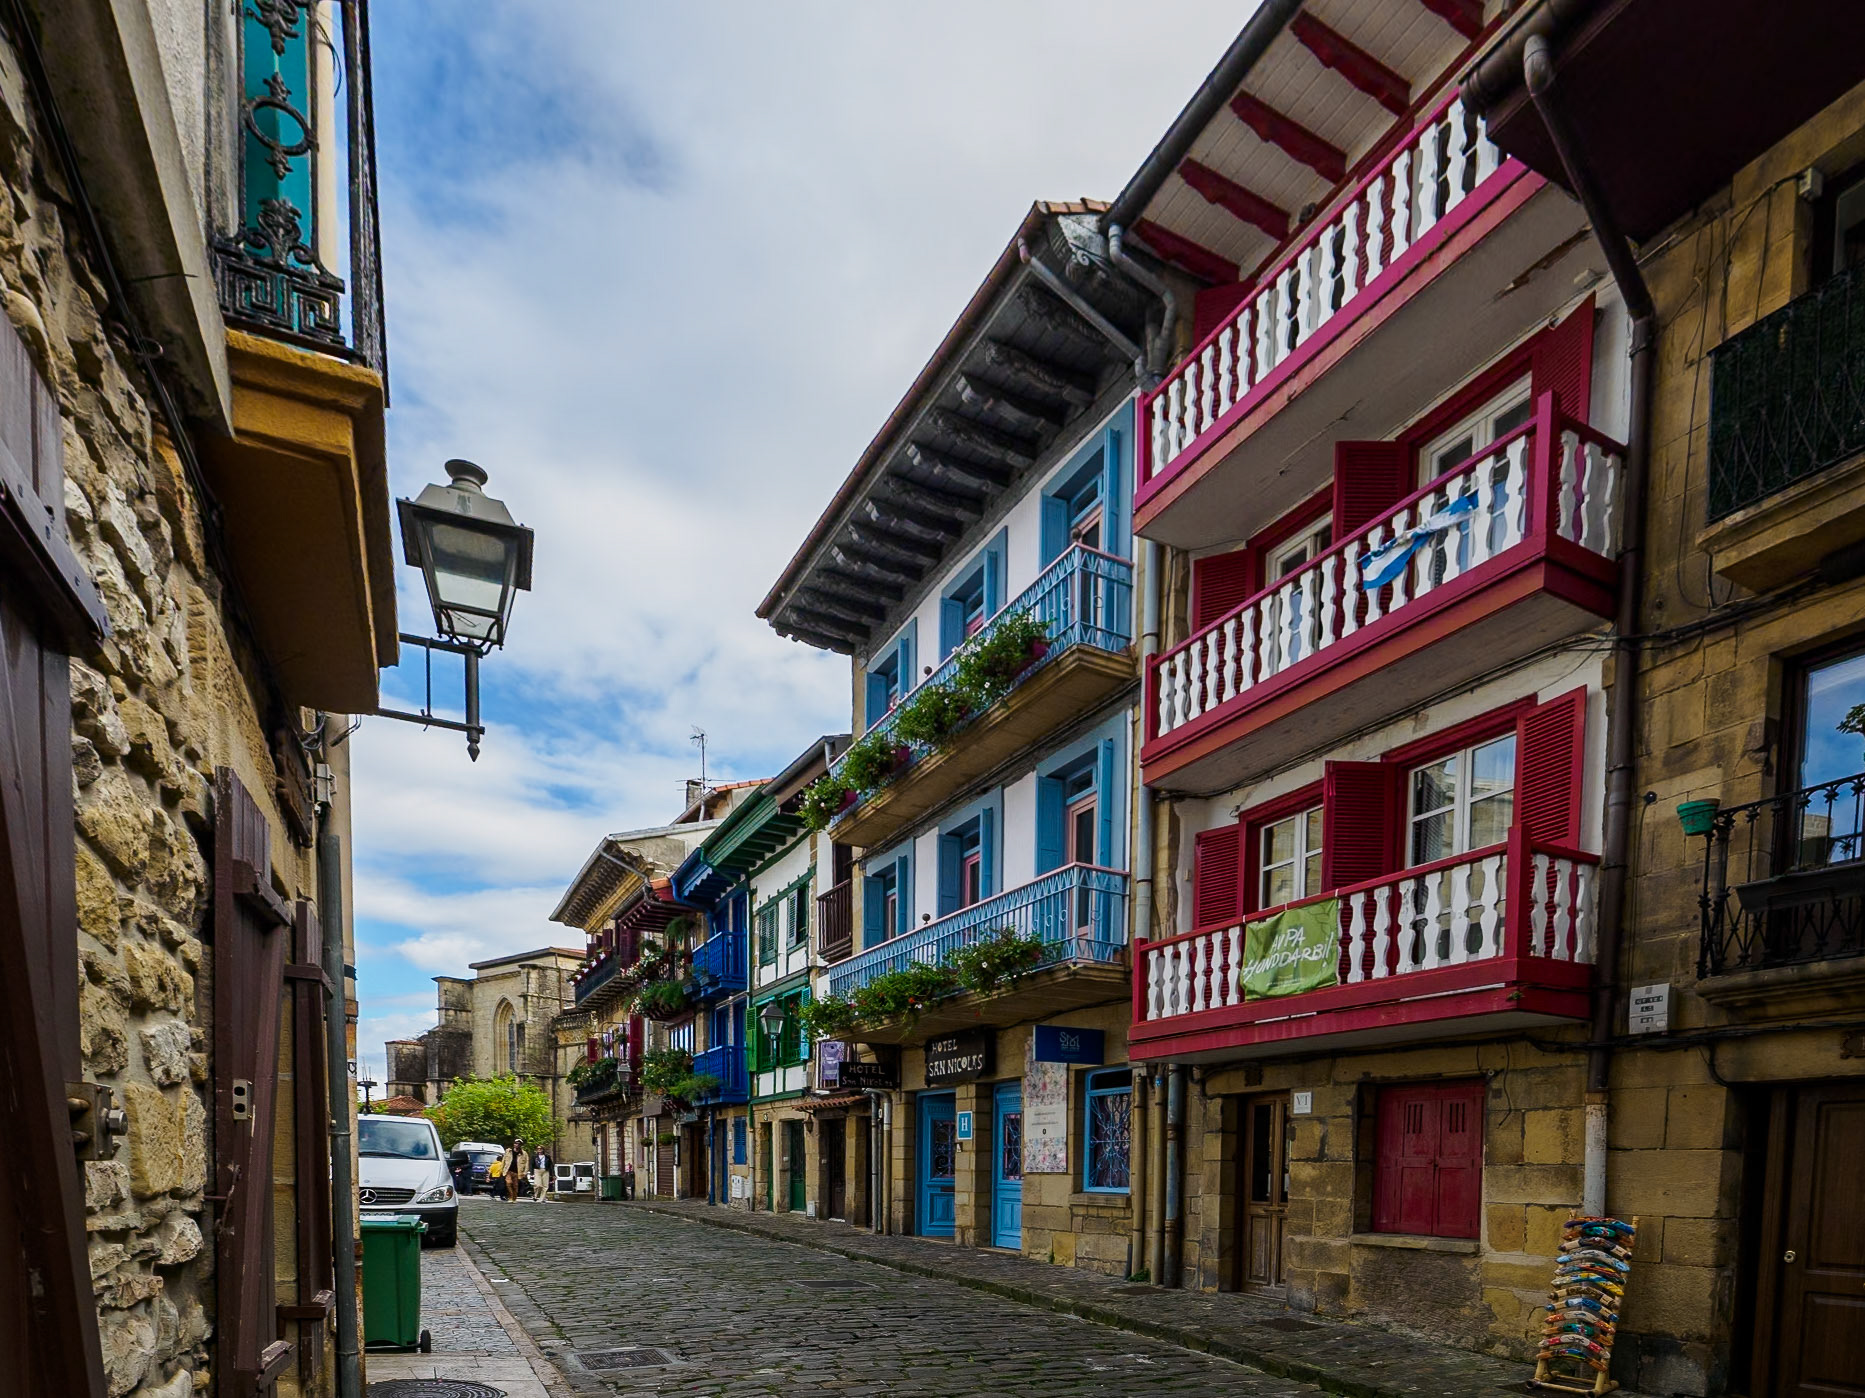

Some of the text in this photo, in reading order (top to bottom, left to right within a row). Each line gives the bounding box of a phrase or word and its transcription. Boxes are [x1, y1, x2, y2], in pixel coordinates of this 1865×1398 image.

[931, 1038, 958, 1055] HOTEL
[849, 1064, 885, 1075] HOTEL
[928, 1060, 946, 1077] SAN
[961, 1117, 968, 1131] H
